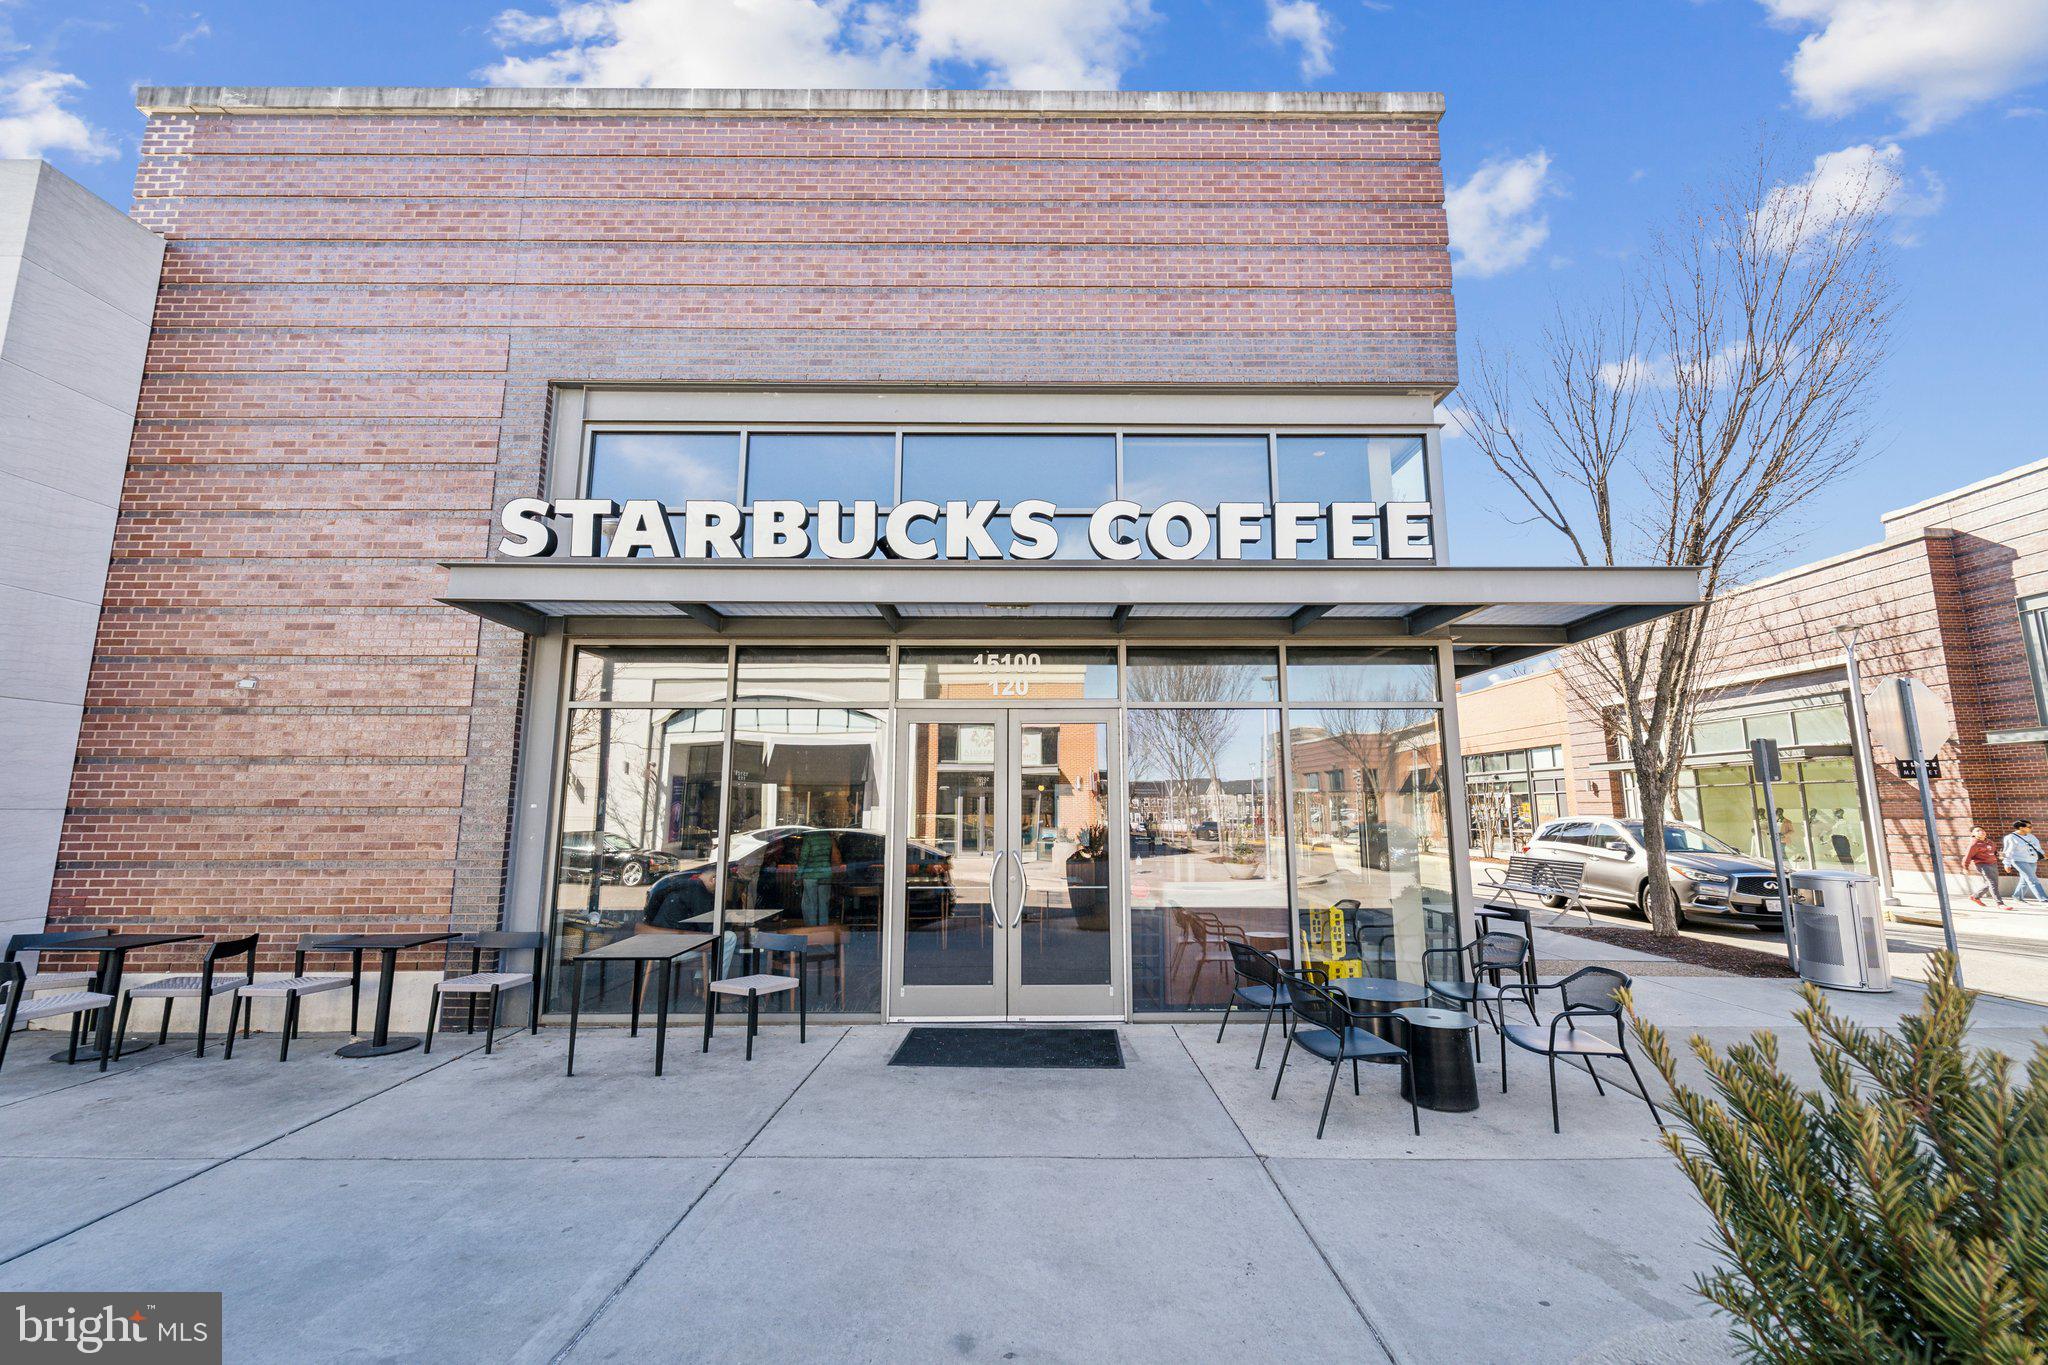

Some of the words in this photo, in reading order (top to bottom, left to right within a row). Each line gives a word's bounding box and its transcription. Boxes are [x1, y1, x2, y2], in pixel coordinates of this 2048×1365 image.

[498, 498, 1059, 560] STARBUCKS
[1087, 499, 1434, 560] COFFEE
[973, 653, 1041, 674] 15100
[987, 677, 1029, 697] 120
